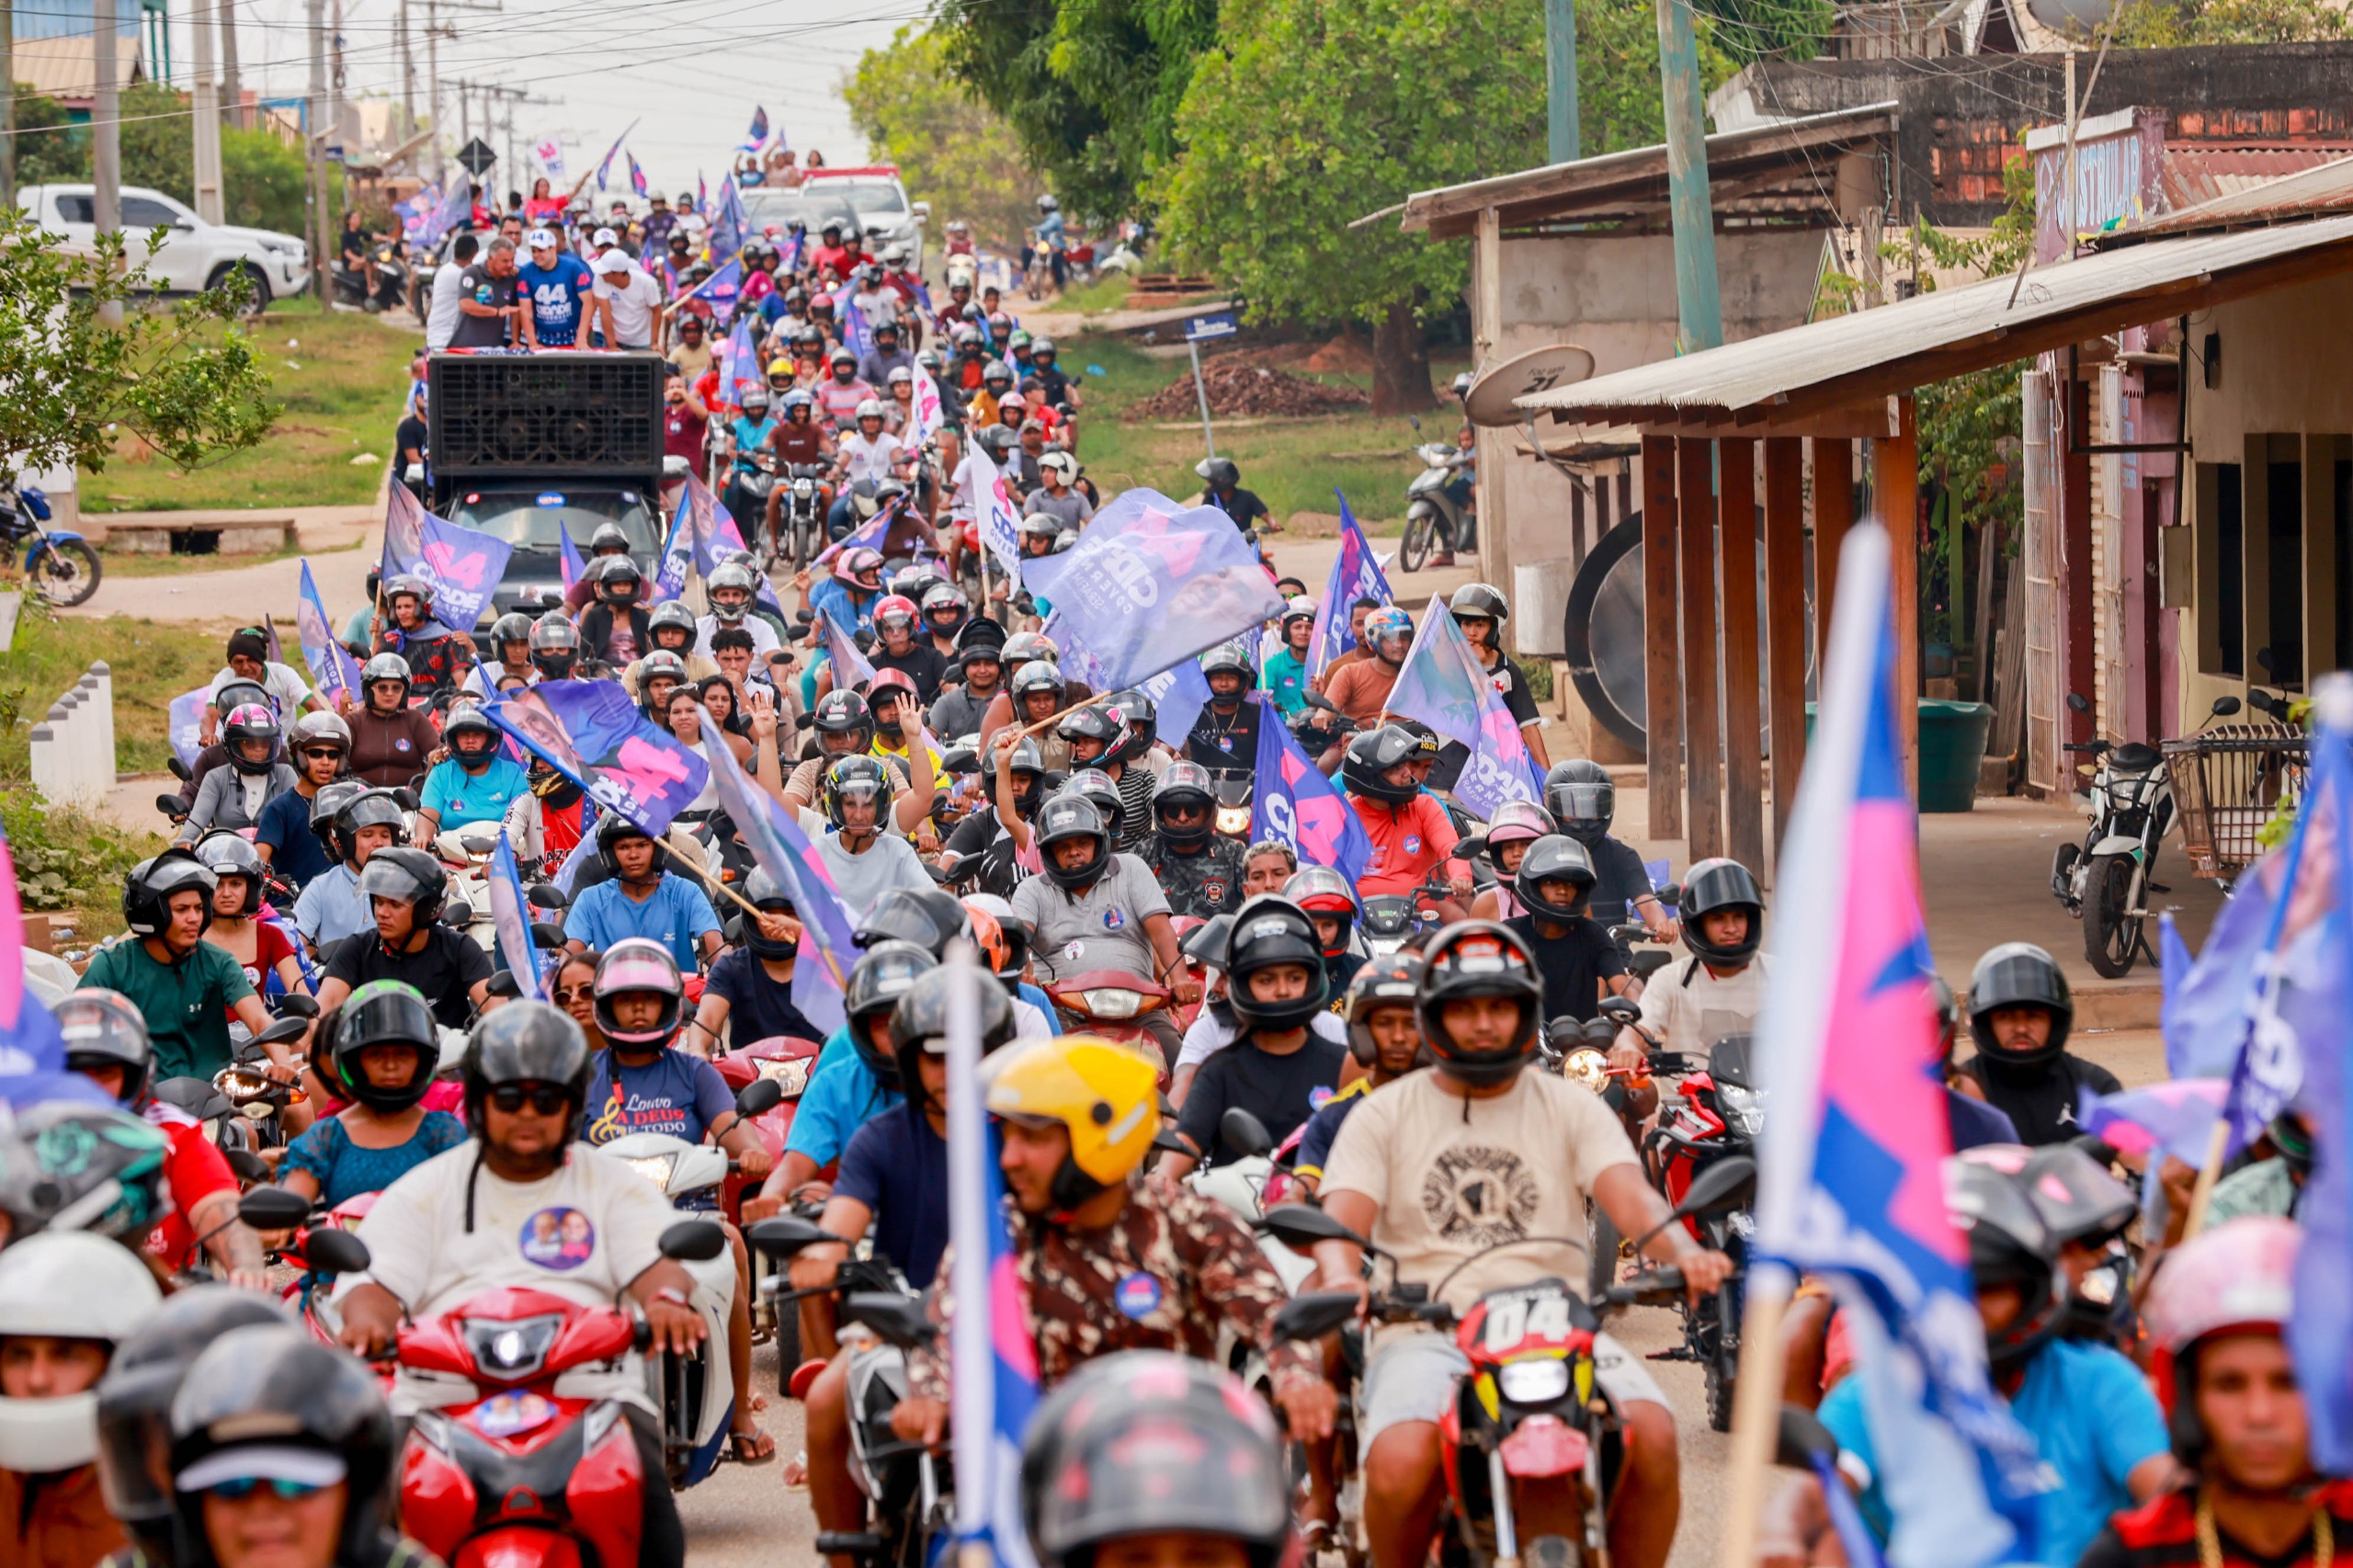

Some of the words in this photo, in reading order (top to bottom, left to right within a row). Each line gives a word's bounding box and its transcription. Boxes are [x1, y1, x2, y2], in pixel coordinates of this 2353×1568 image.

[2056, 135, 2140, 229] CSTRULAR
[535, 285, 568, 304] 44
[625, 1093, 672, 1111] Louvo
[615, 1110, 629, 1125] A
[633, 1108, 685, 1125] DEUS
[642, 1120, 687, 1133] TODO
[1484, 1297, 1573, 1355] 04
